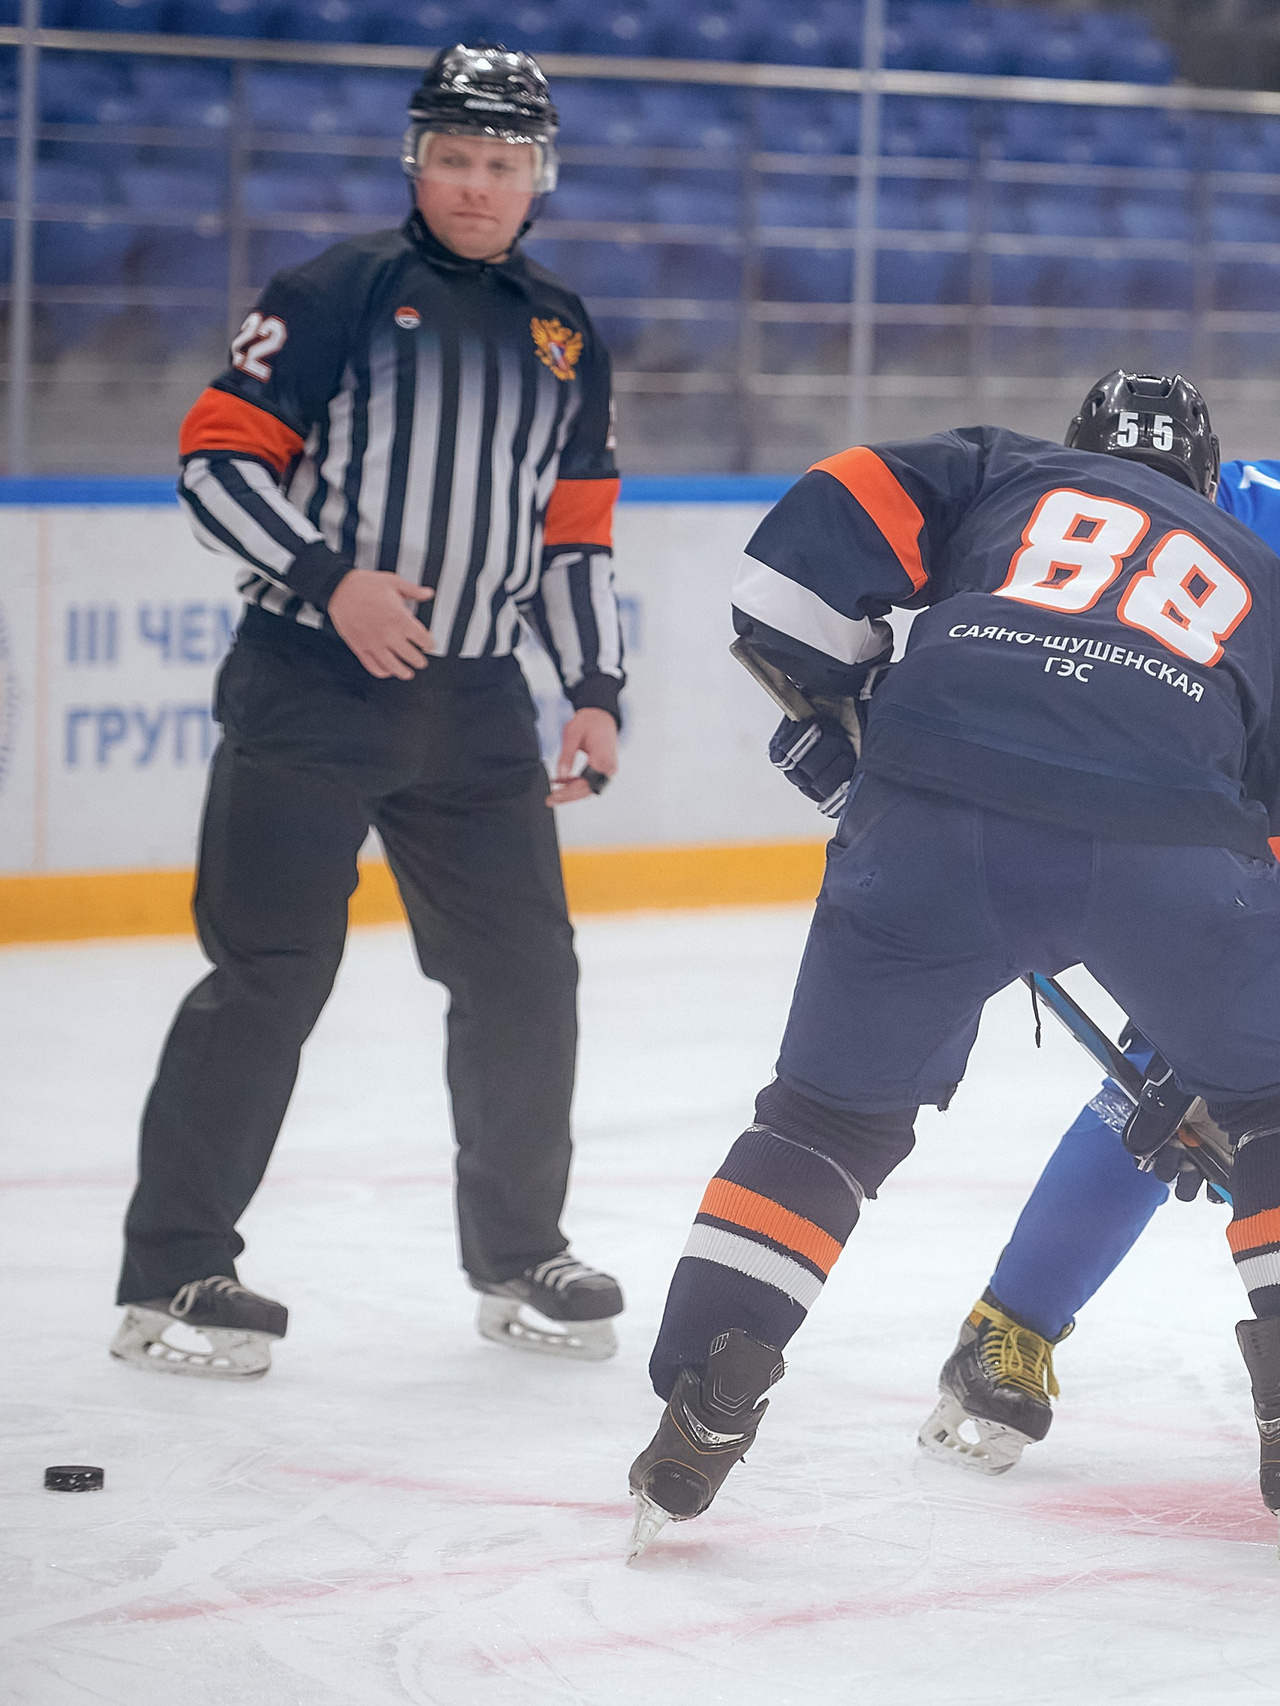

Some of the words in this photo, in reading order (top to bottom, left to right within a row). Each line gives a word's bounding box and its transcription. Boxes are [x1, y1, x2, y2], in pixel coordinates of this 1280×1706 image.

[231, 312, 287, 382] 22
[1116, 411, 1174, 451] 55
[991, 487, 1253, 668] 88
[137, 604, 236, 664] ЧЕ
[948, 624, 1205, 702] САЯНО-ШУШЕНСКАЯ
[1044, 656, 1094, 682] ГЭС
[65, 705, 211, 767] ГРУП
